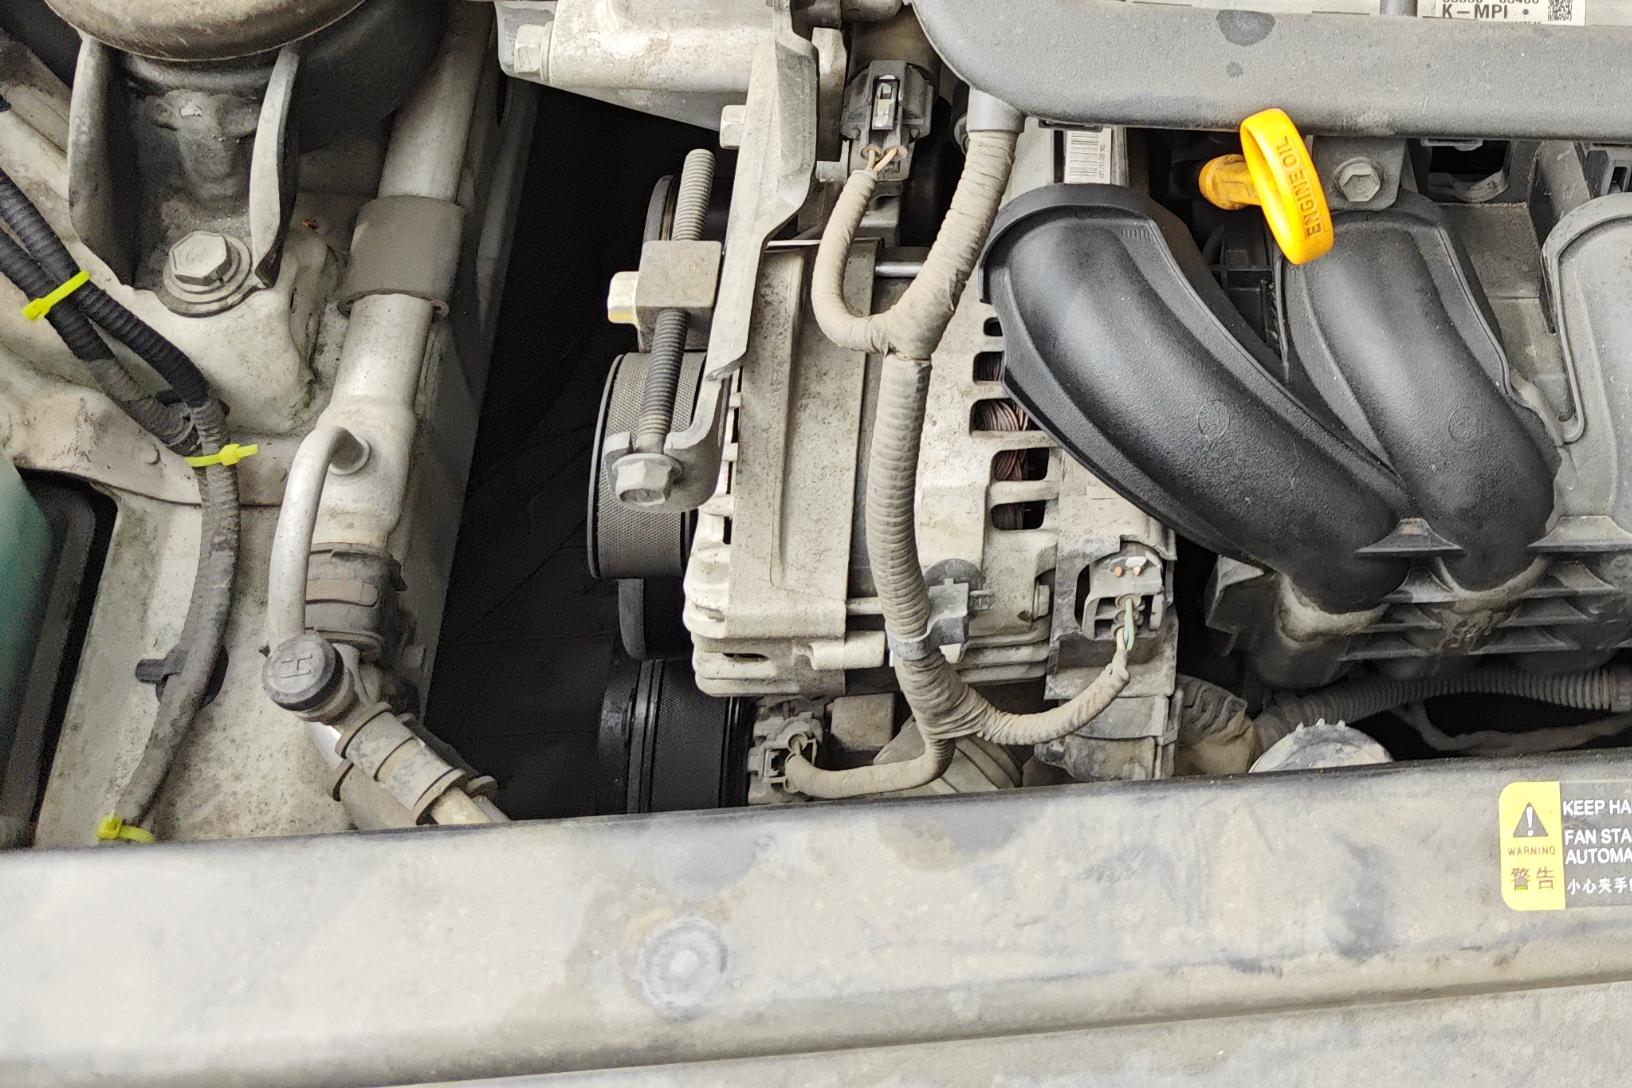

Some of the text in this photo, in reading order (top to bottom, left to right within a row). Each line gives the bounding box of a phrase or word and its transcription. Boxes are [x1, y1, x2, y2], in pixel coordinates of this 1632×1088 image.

[1275, 135, 1322, 237] ENGINE OIL
[1563, 799, 1605, 816] KEEP
[1565, 829, 1597, 845] FAN
[1507, 845, 1556, 857] WARNING
[1510, 866, 1556, 892] 警告
